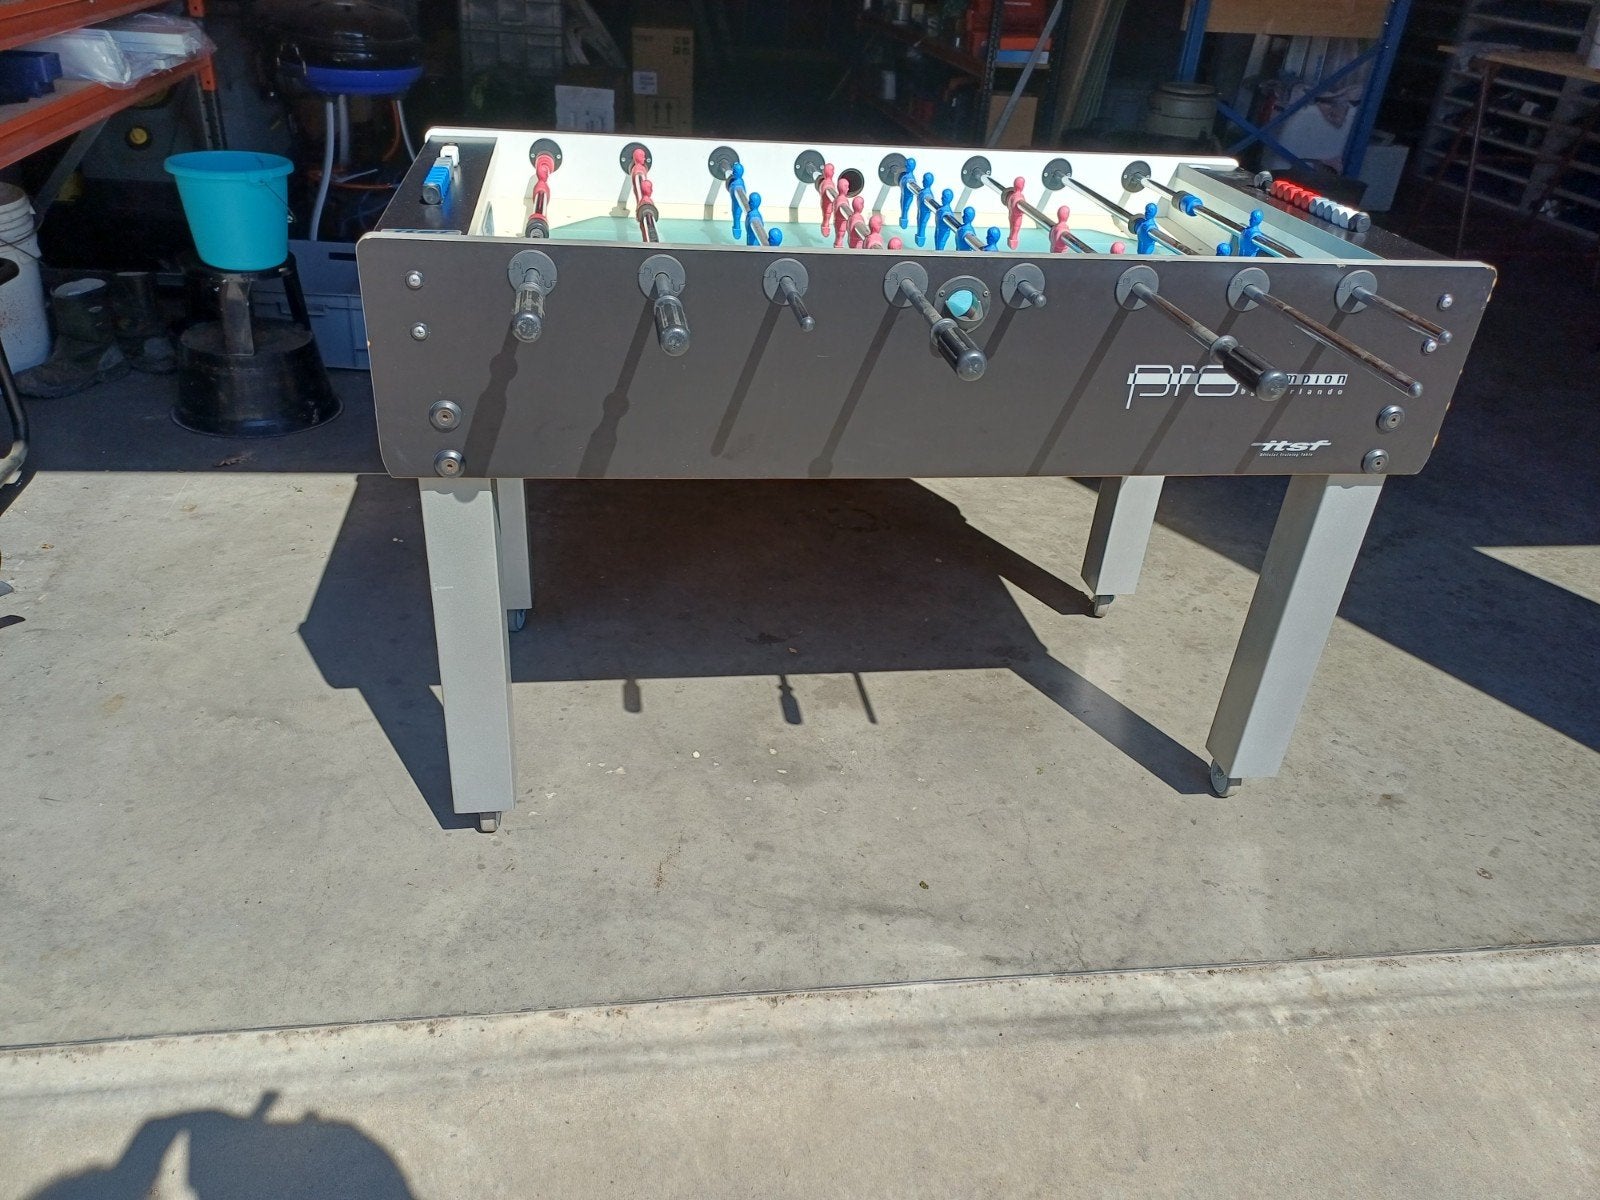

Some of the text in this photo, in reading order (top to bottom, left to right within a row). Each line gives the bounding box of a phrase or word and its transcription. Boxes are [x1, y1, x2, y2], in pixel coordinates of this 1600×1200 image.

[1126, 364, 1347, 410] pro mpion
[1252, 440, 1331, 451] itsf
